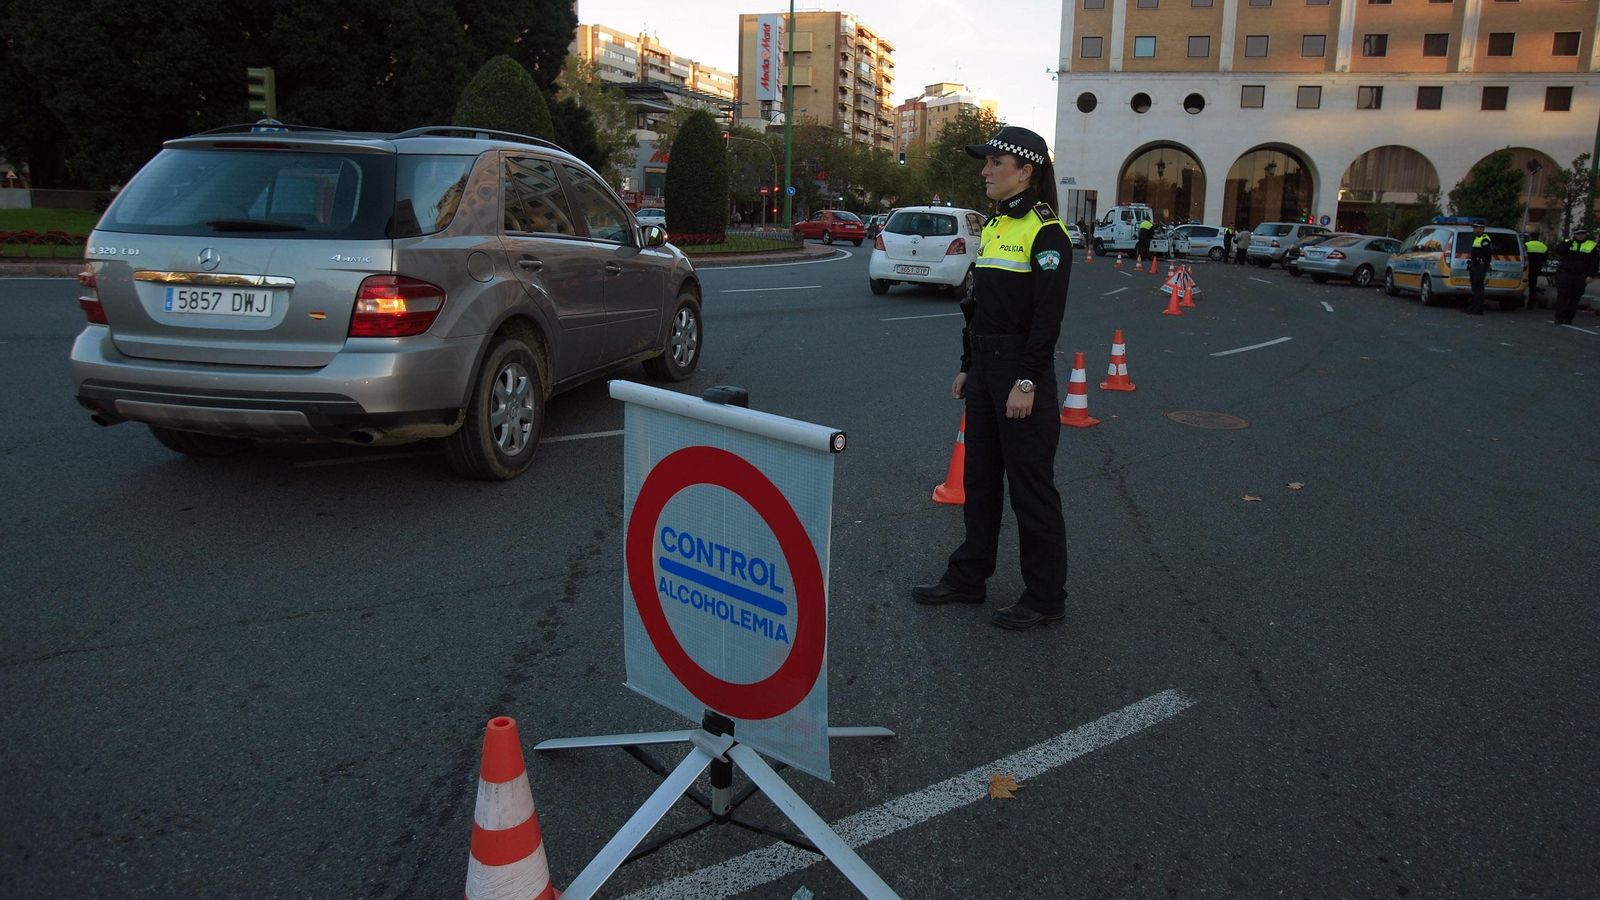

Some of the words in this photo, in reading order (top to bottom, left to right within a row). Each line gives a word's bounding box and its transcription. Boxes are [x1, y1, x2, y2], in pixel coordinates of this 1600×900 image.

[999, 244, 1024, 253] POLICIA
[178, 290, 223, 311] 5857
[231, 292, 268, 313] DWJ
[660, 526, 785, 594] CONTROL
[658, 576, 790, 645] ALCOHOLEMIA
